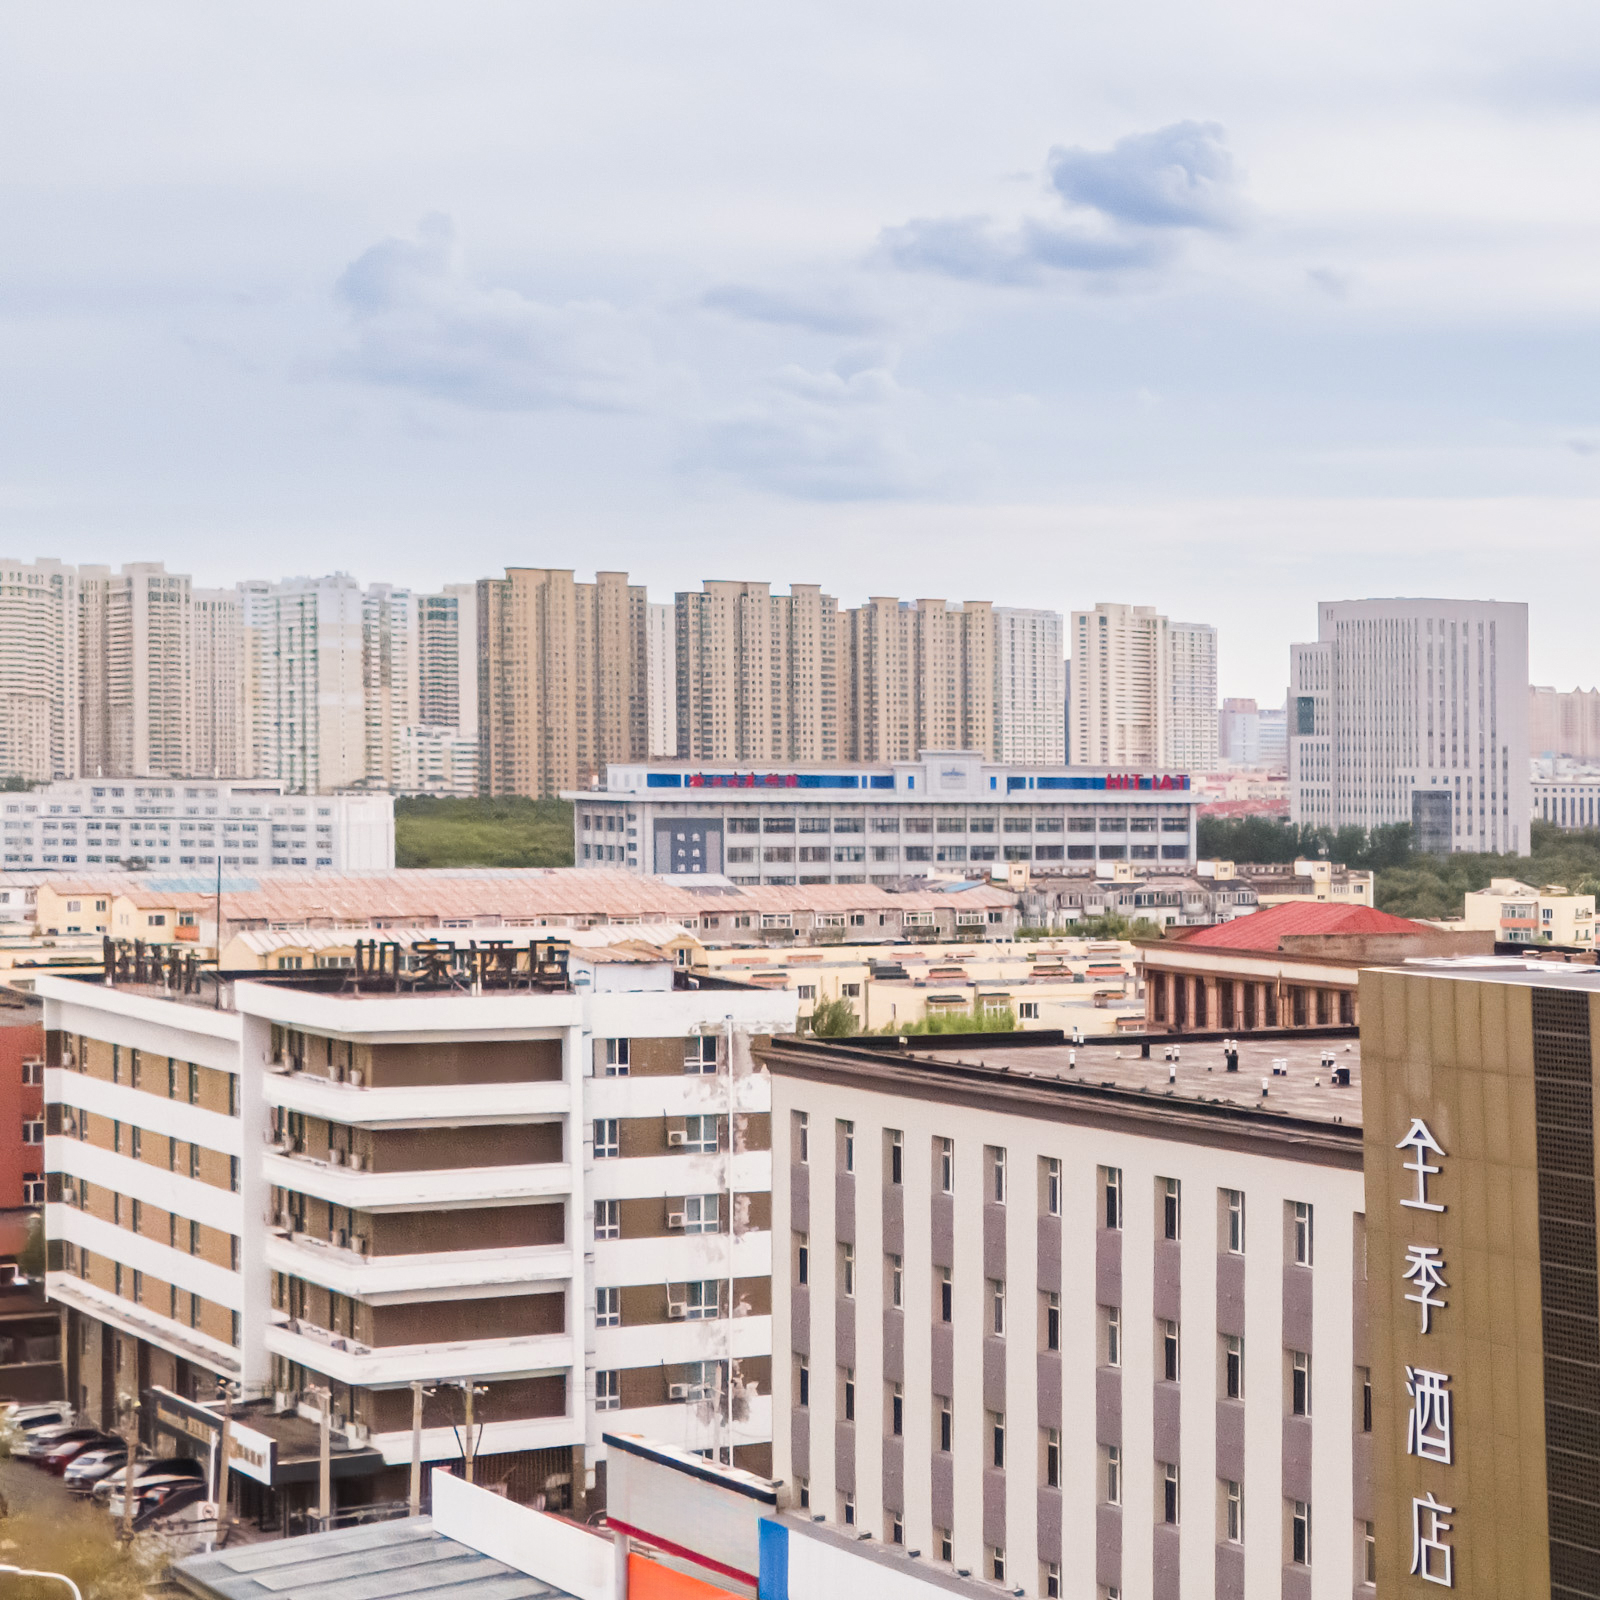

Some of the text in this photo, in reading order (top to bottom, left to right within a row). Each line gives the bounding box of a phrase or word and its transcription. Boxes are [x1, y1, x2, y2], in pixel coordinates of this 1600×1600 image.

[1106, 773, 1143, 790] HIT
[1395, 1118, 1454, 1588] 全季酒店
